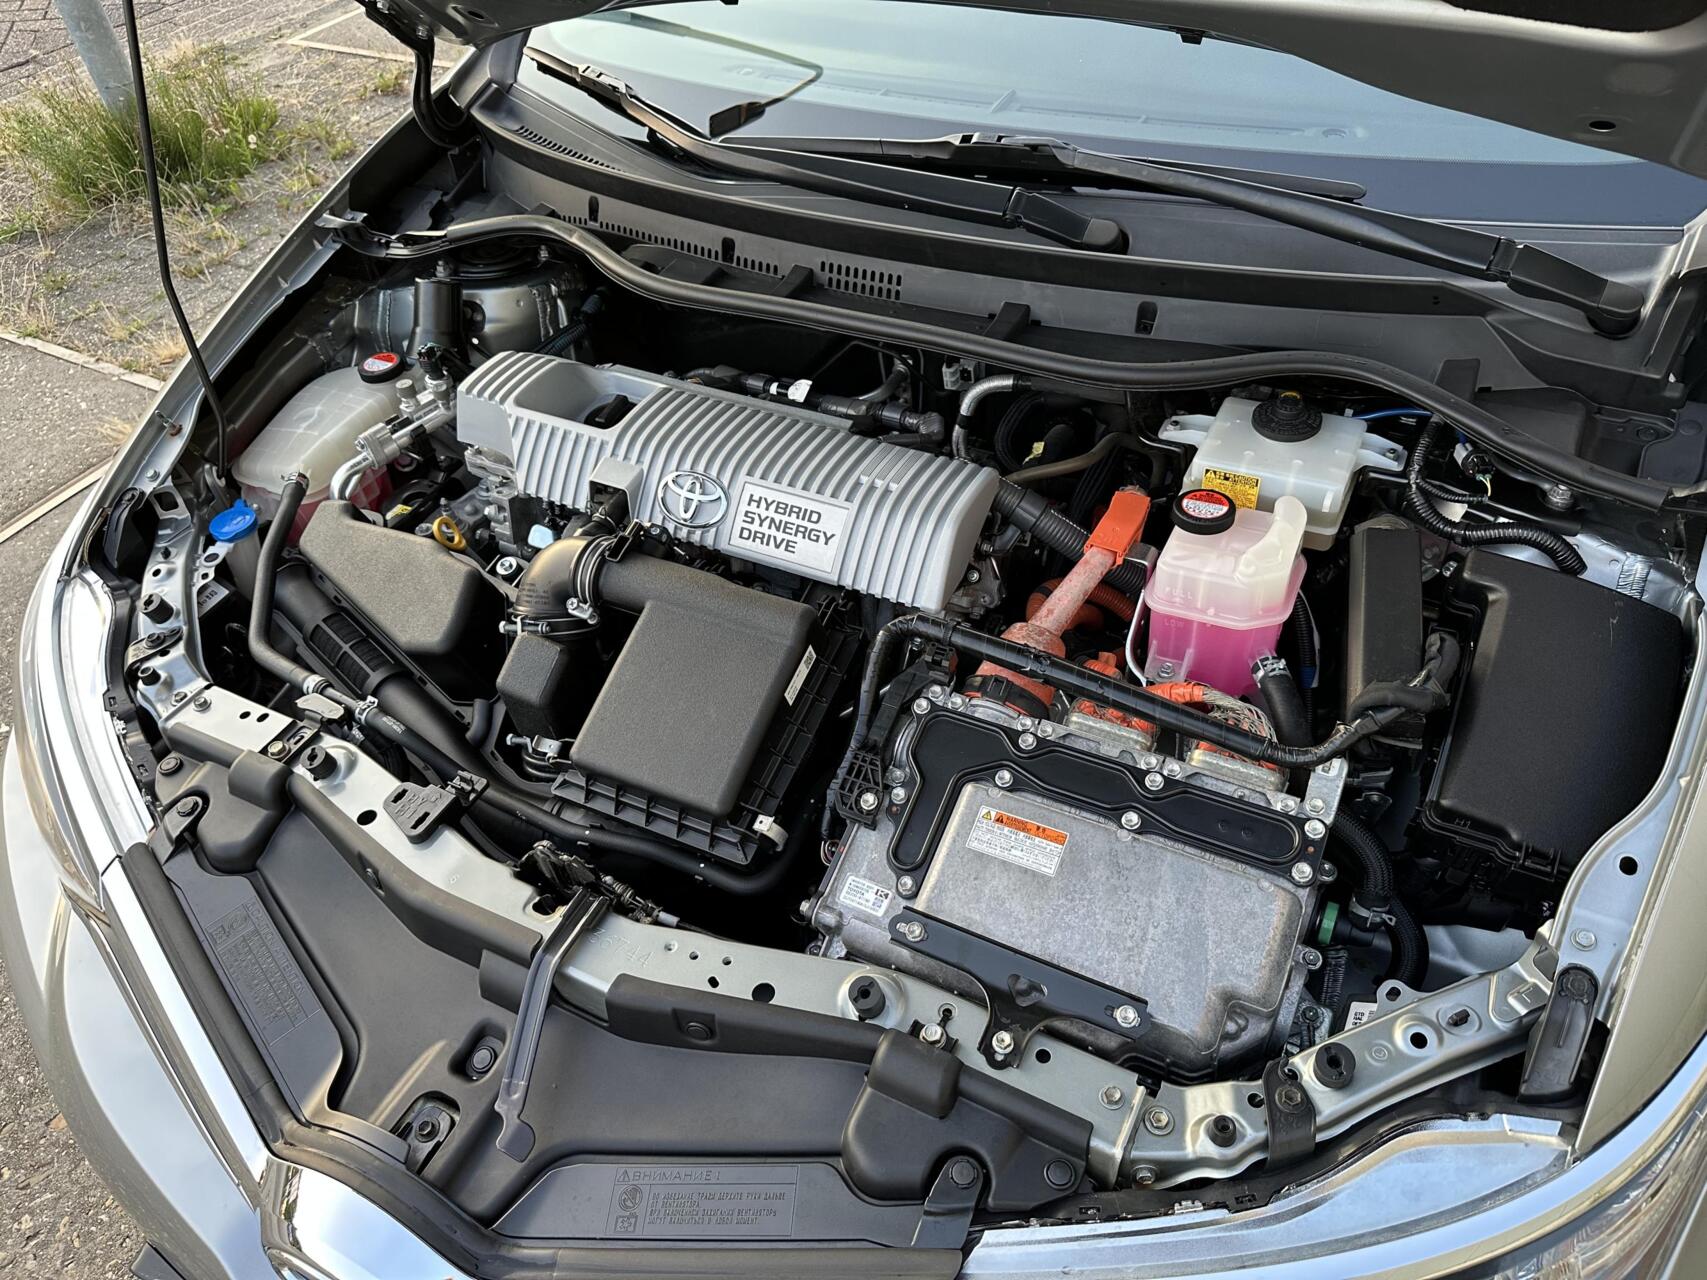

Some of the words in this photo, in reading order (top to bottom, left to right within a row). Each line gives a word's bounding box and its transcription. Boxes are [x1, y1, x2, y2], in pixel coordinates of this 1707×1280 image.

[747, 493, 822, 525] HYBRID
[738, 526, 798, 554] DRIVE
[742, 510, 836, 546] SYNERGY
